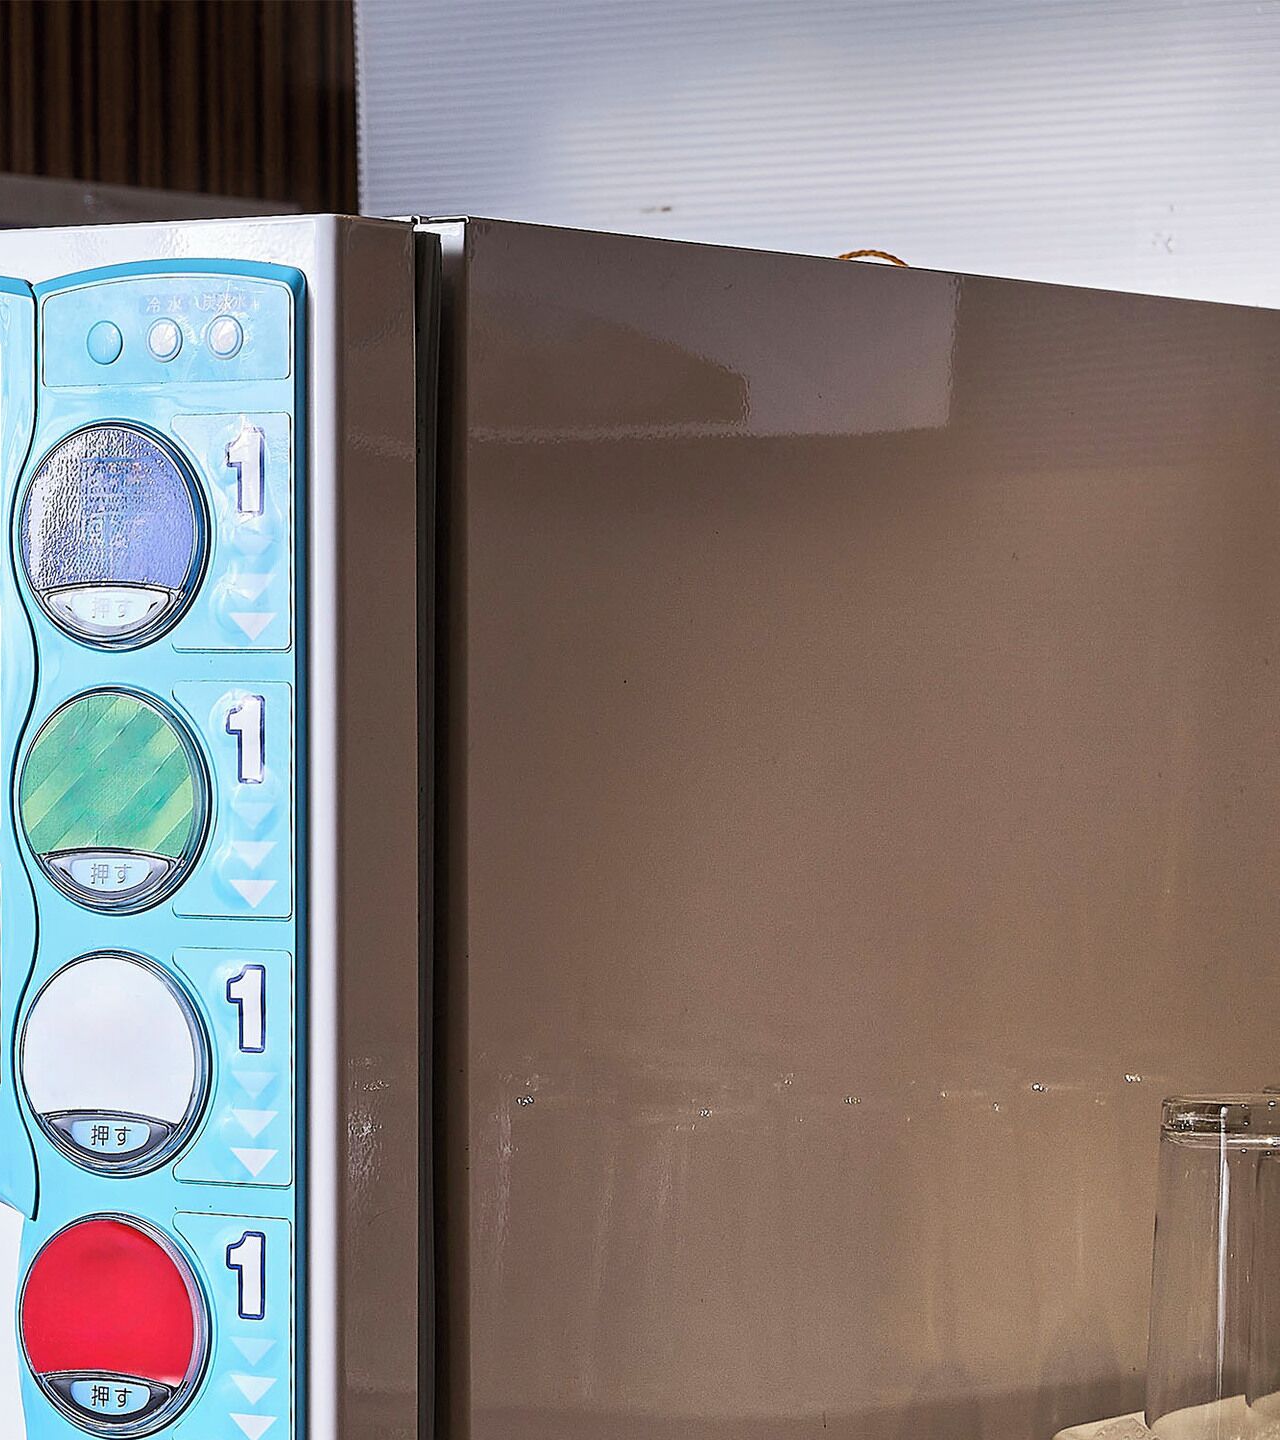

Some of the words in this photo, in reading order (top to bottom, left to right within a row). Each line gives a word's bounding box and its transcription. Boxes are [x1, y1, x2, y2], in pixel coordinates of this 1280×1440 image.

[225, 426, 266, 516] 1
[225, 695, 266, 785] 1
[90, 863, 132, 885] 押す
[226, 964, 267, 1054] 1
[90, 1124, 132, 1147] 押す
[226, 1231, 267, 1321] 1
[90, 1385, 132, 1409] 押す
